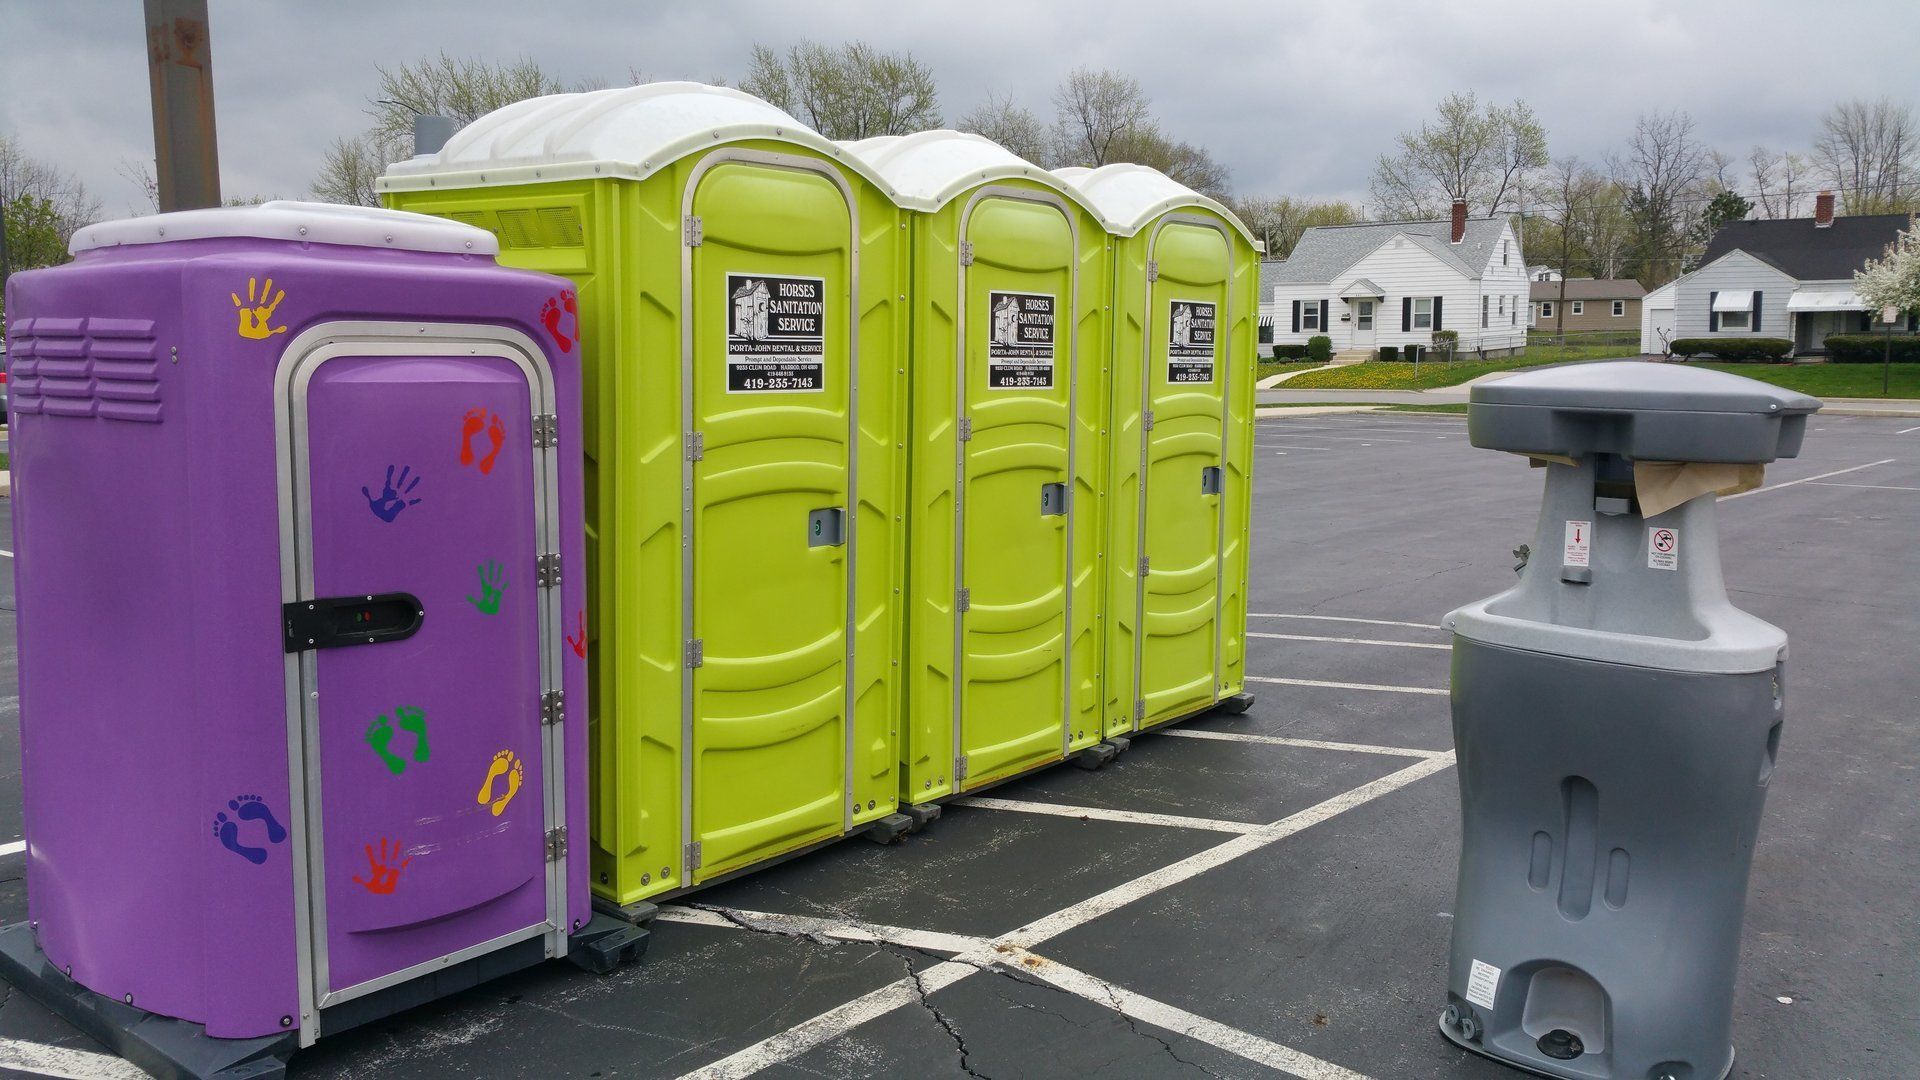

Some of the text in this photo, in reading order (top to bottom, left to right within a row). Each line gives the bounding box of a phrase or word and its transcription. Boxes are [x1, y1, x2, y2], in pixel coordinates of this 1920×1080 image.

[780, 284, 815, 298] HORSES
[770, 300, 822, 314] SANITATION
[1025, 299, 1050, 310] HORSES
[1196, 306, 1212, 316] HORSES
[1018, 313, 1054, 325] SANITATION
[778, 318, 816, 332] SERVICE
[1024, 328, 1049, 340] SERVICE
[1194, 331, 1212, 340] SERVICE
[744, 378, 813, 389] 419-235-7143
[1000, 377, 1047, 386] 419-235-7143
